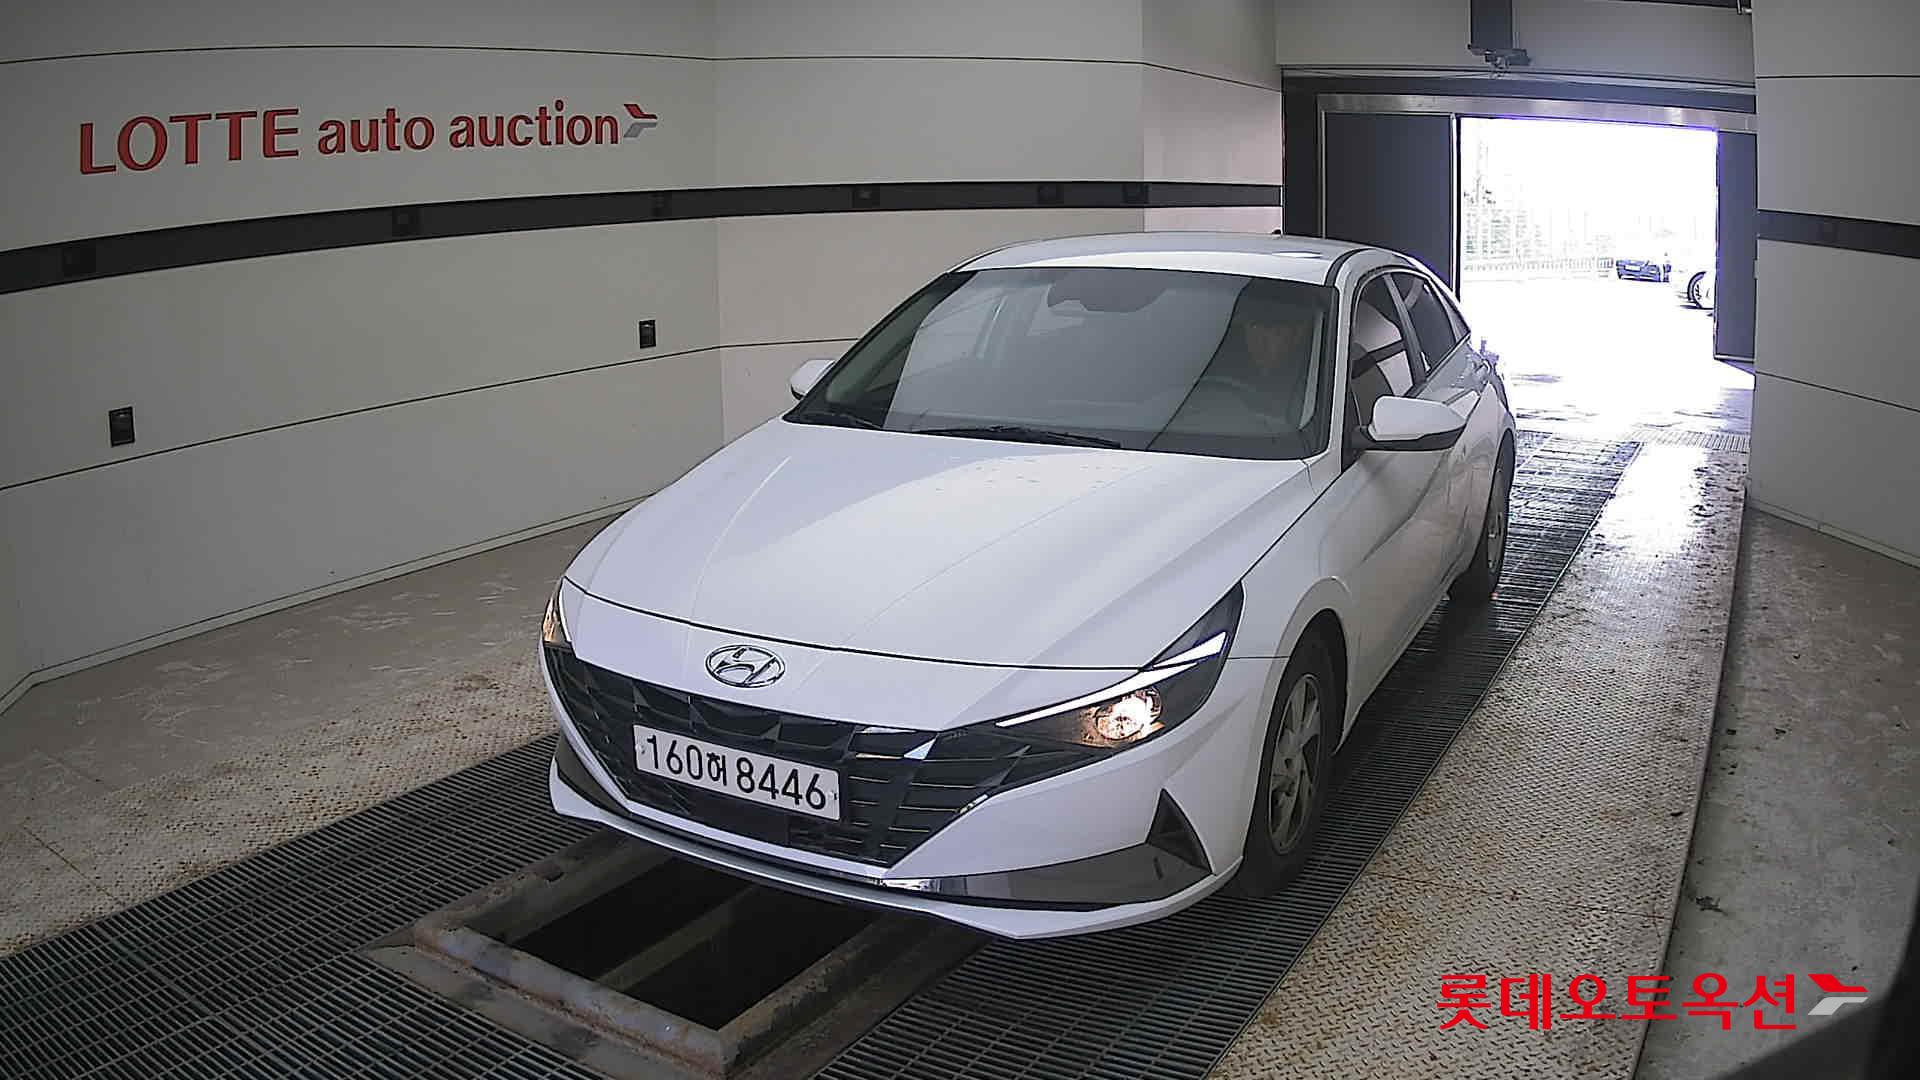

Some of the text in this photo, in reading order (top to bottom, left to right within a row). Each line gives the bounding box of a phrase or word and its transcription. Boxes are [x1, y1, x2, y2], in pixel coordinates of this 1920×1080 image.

[79, 101, 619, 175] LOTTE auto auction
[647, 735, 826, 810] 160허 8446
